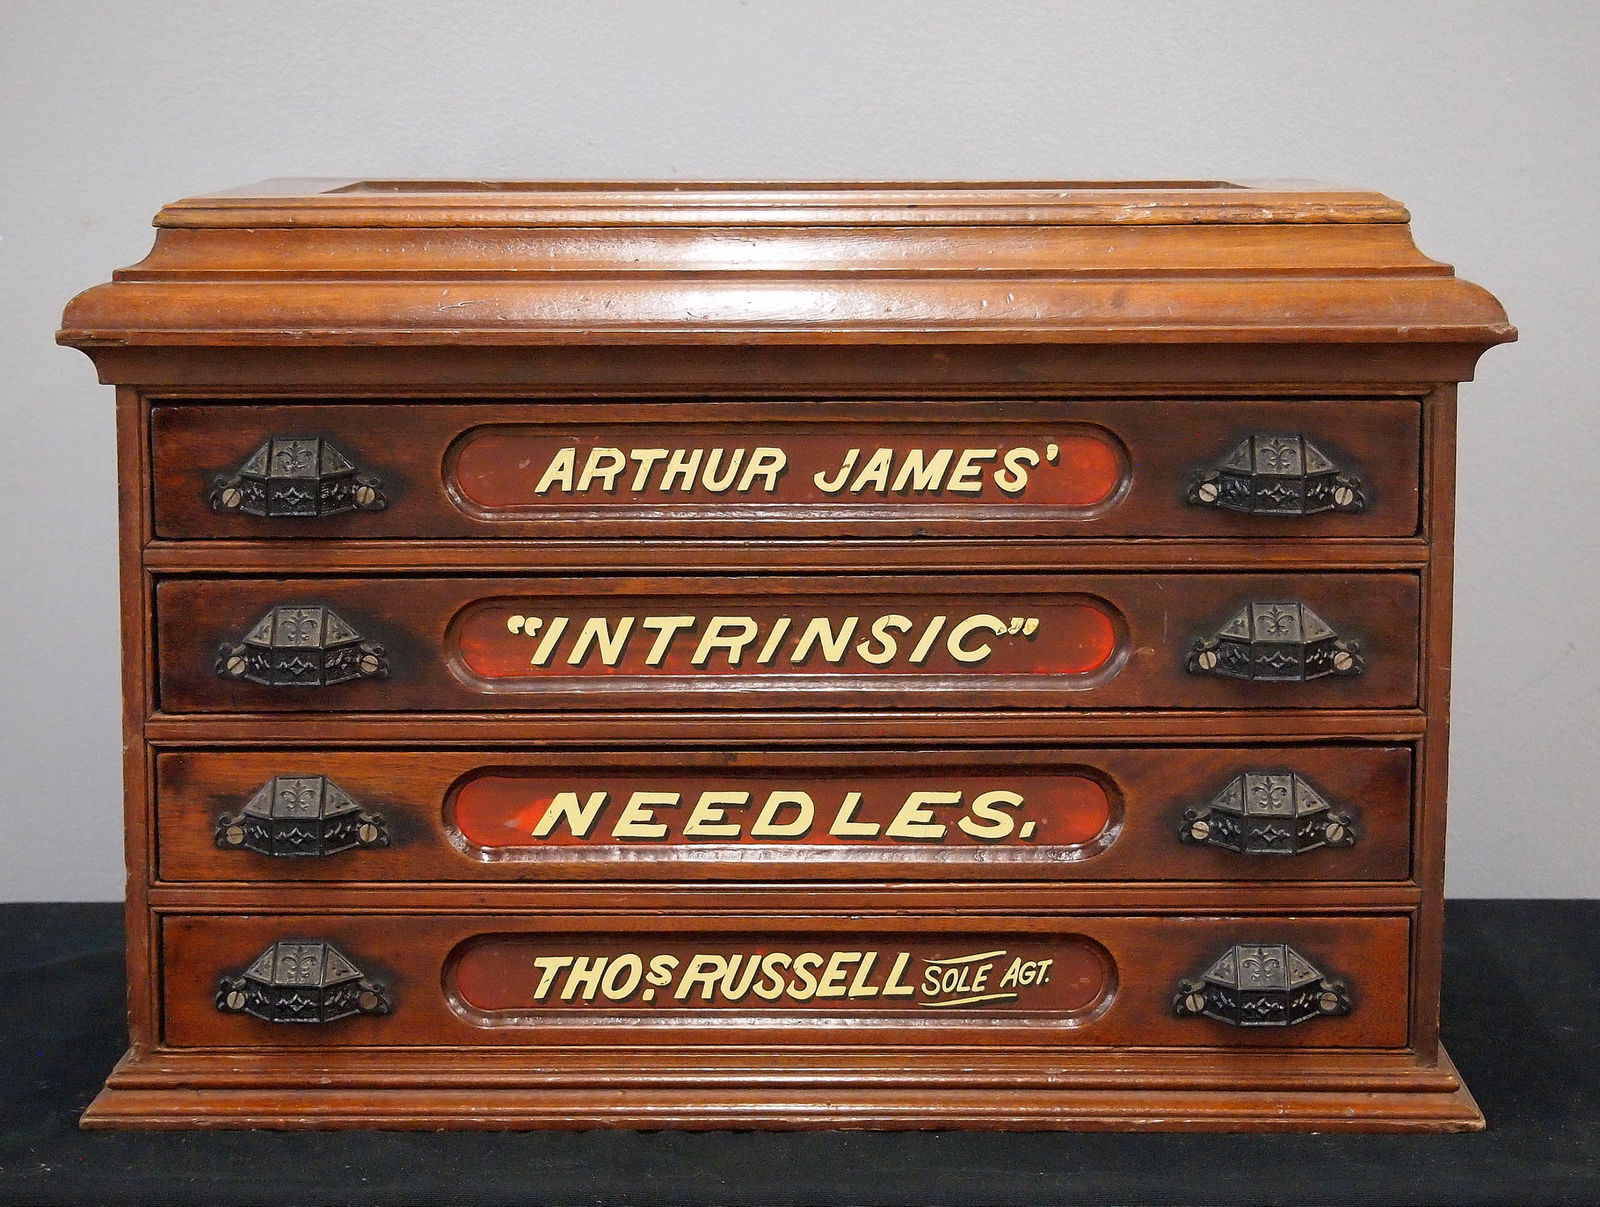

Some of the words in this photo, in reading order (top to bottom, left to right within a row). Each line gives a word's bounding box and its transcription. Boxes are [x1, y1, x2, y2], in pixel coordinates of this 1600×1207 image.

[535, 447, 787, 493] ARTHUR
[813, 443, 1059, 493] JAMES'
[531, 790, 1036, 839] NEEDLES.
[673, 951, 915, 1000] RUSSELL
[921, 963, 993, 996] SOLE
[999, 956, 1053, 988] AGT.
